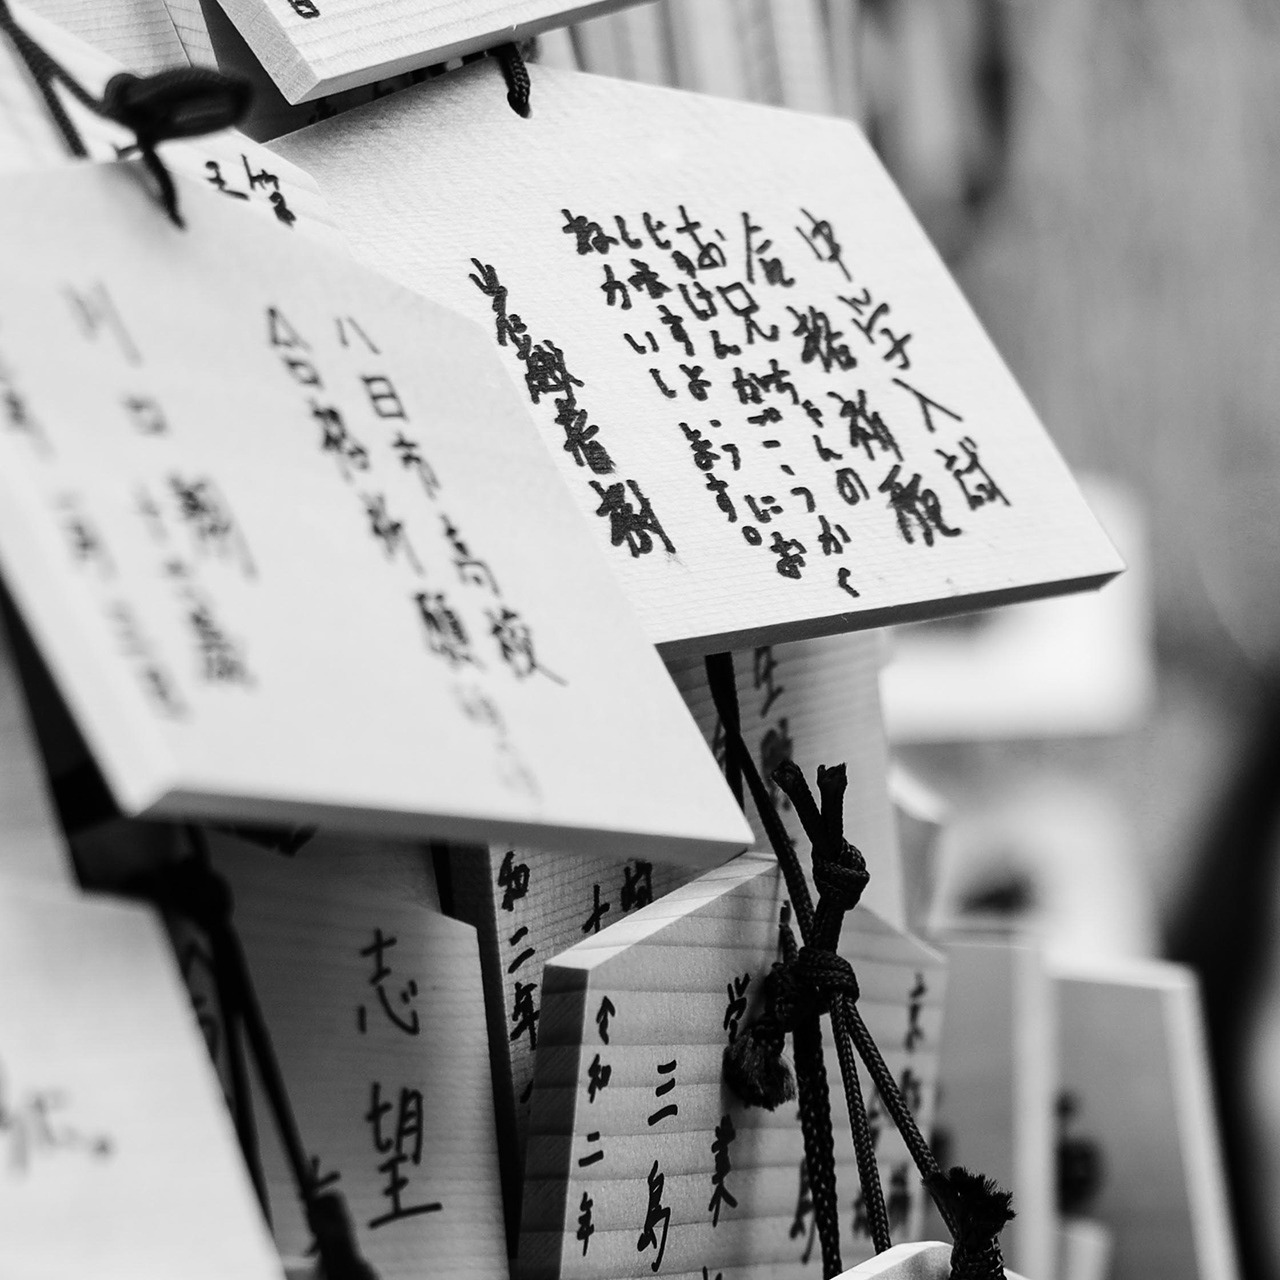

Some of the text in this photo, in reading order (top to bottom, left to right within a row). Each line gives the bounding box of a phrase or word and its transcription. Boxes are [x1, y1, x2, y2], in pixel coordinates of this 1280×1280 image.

[740, 211, 963, 547] 合格祈願
[796, 206, 1012, 508] 中学入試
[357, 927, 443, 1230] 志望
